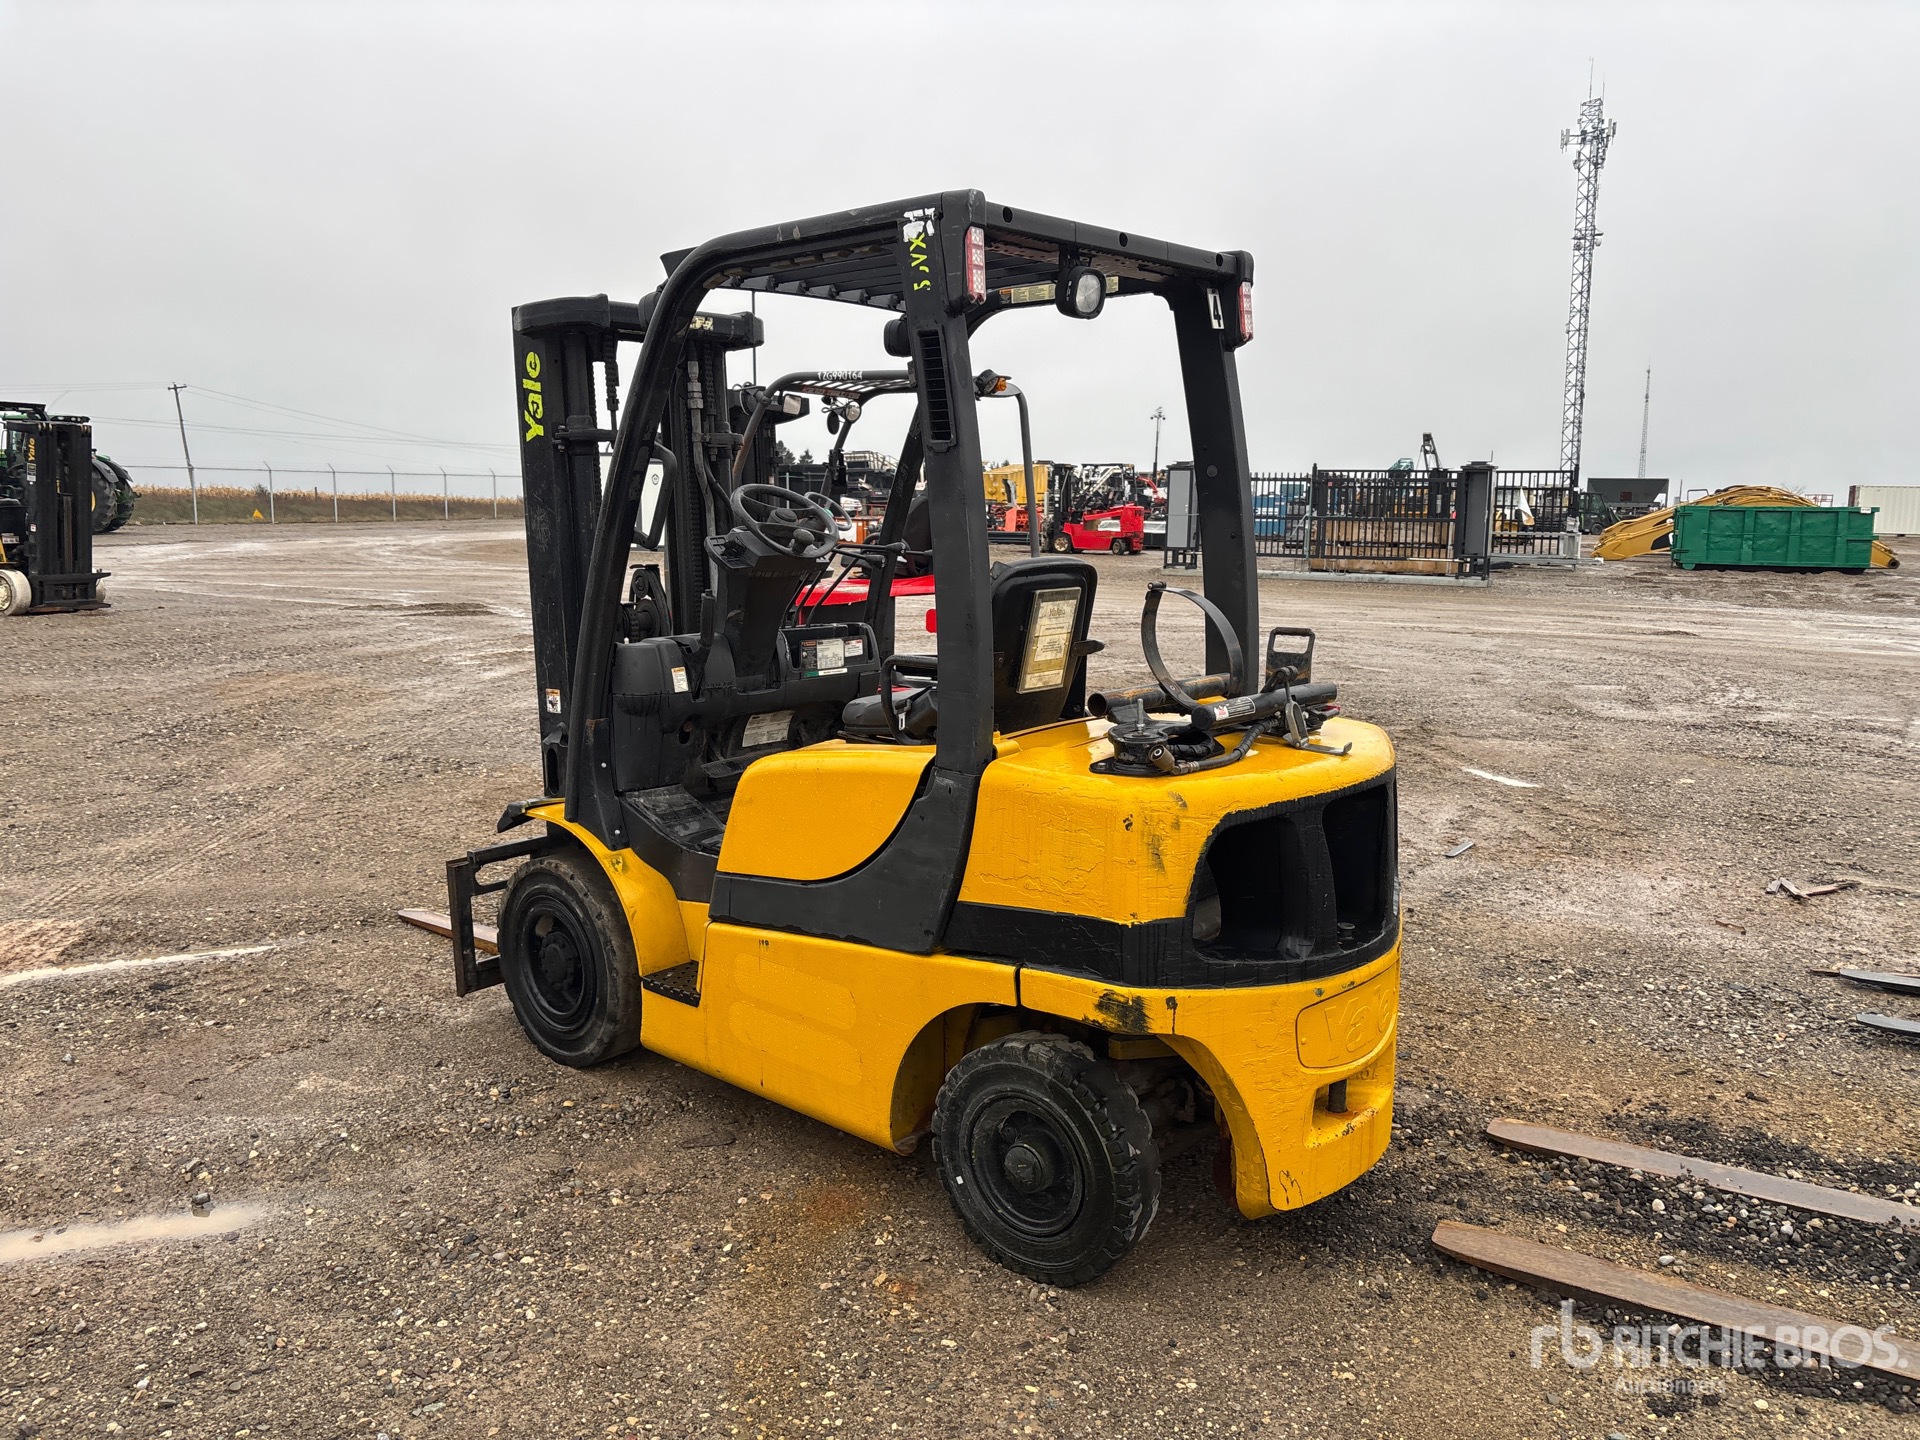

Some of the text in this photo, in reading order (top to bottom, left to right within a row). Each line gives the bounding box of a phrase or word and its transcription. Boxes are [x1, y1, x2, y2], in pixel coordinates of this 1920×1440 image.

[1213, 295, 1222, 328] 4
[522, 351, 544, 442] Yale
[28, 437, 36, 461] Yale
